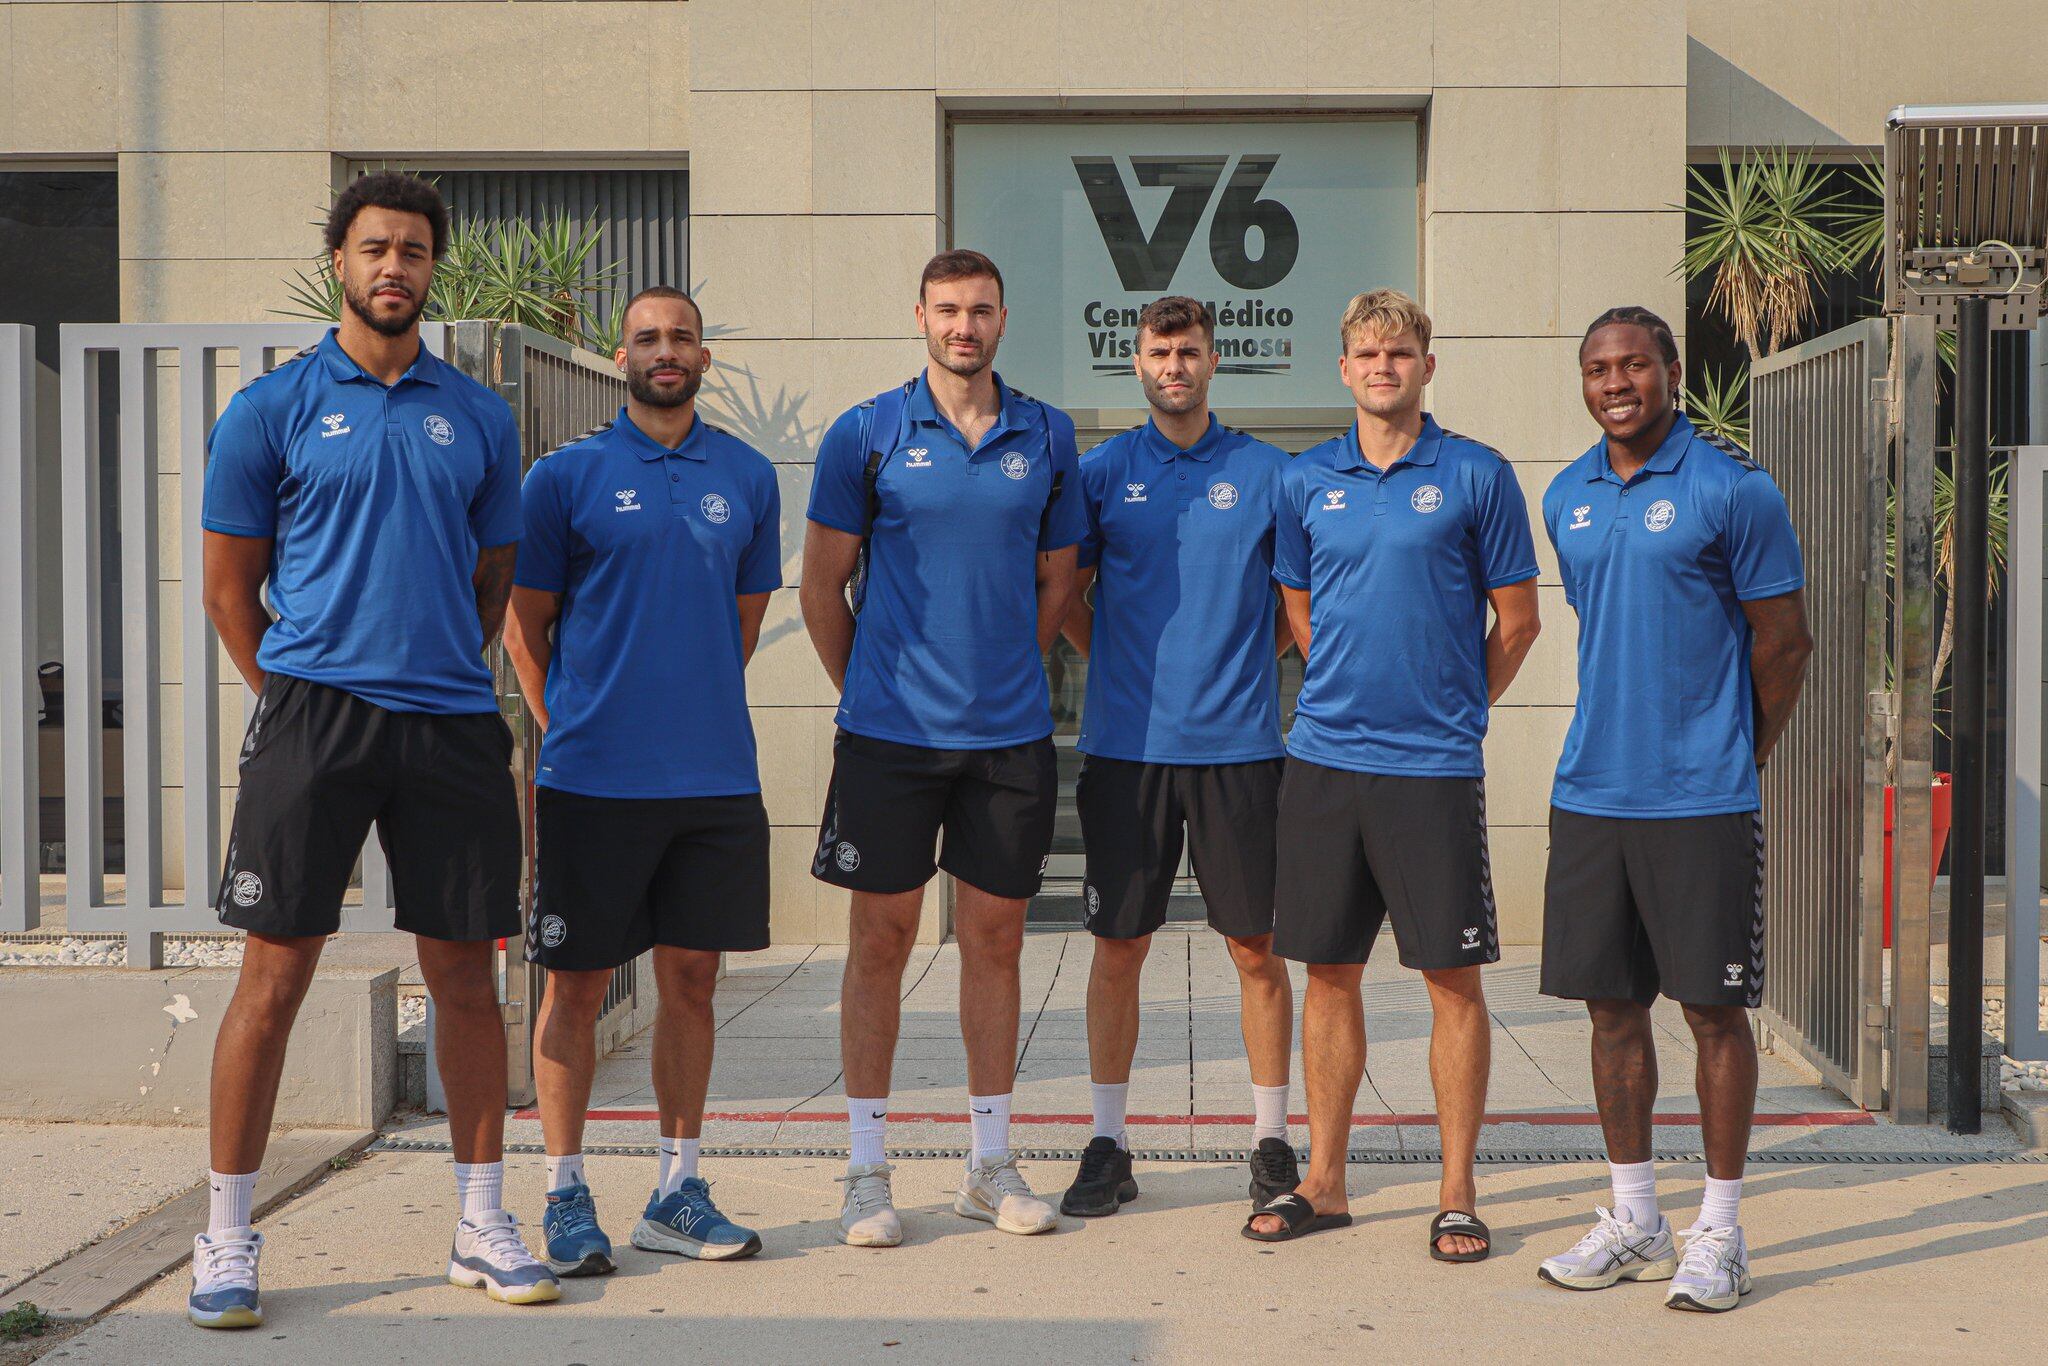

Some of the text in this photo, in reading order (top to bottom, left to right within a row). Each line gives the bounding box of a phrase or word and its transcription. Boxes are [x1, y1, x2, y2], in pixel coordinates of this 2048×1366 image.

[1084, 301, 1149, 328] Cen
[322, 426, 350, 439] hummel
[906, 460, 932, 468] hummel
[615, 503, 641, 512] hummel
[1445, 1212, 1472, 1222] NIKE
